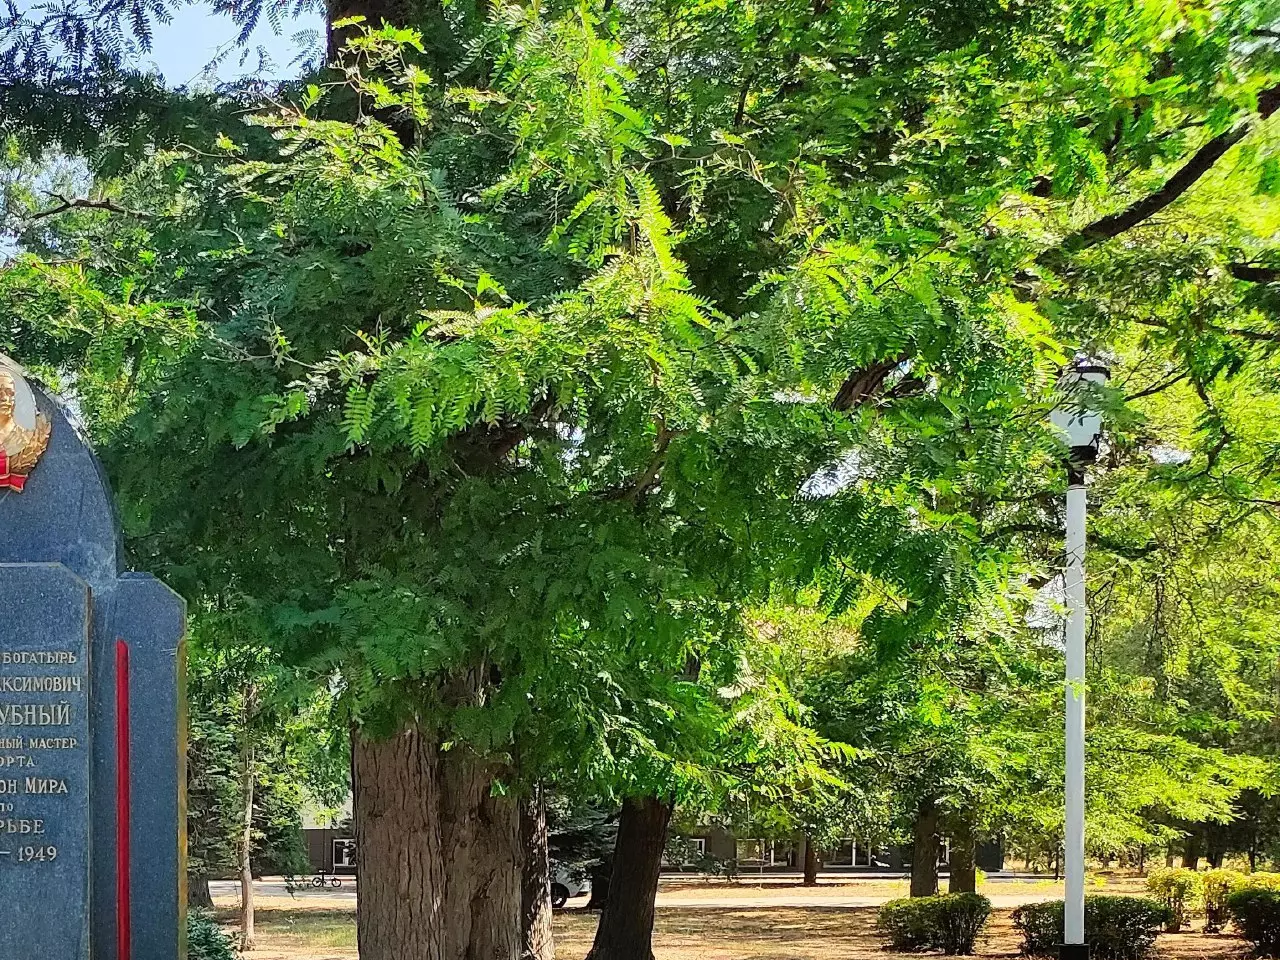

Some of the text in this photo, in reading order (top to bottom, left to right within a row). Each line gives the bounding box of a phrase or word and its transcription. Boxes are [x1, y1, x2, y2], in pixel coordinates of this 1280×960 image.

[3, 650, 77, 664] БОГАТЫРЬ
[29, 737, 77, 749] МАСТЕР
[25, 777, 68, 794] МИРА
[18, 846, 57, 862] 1949
